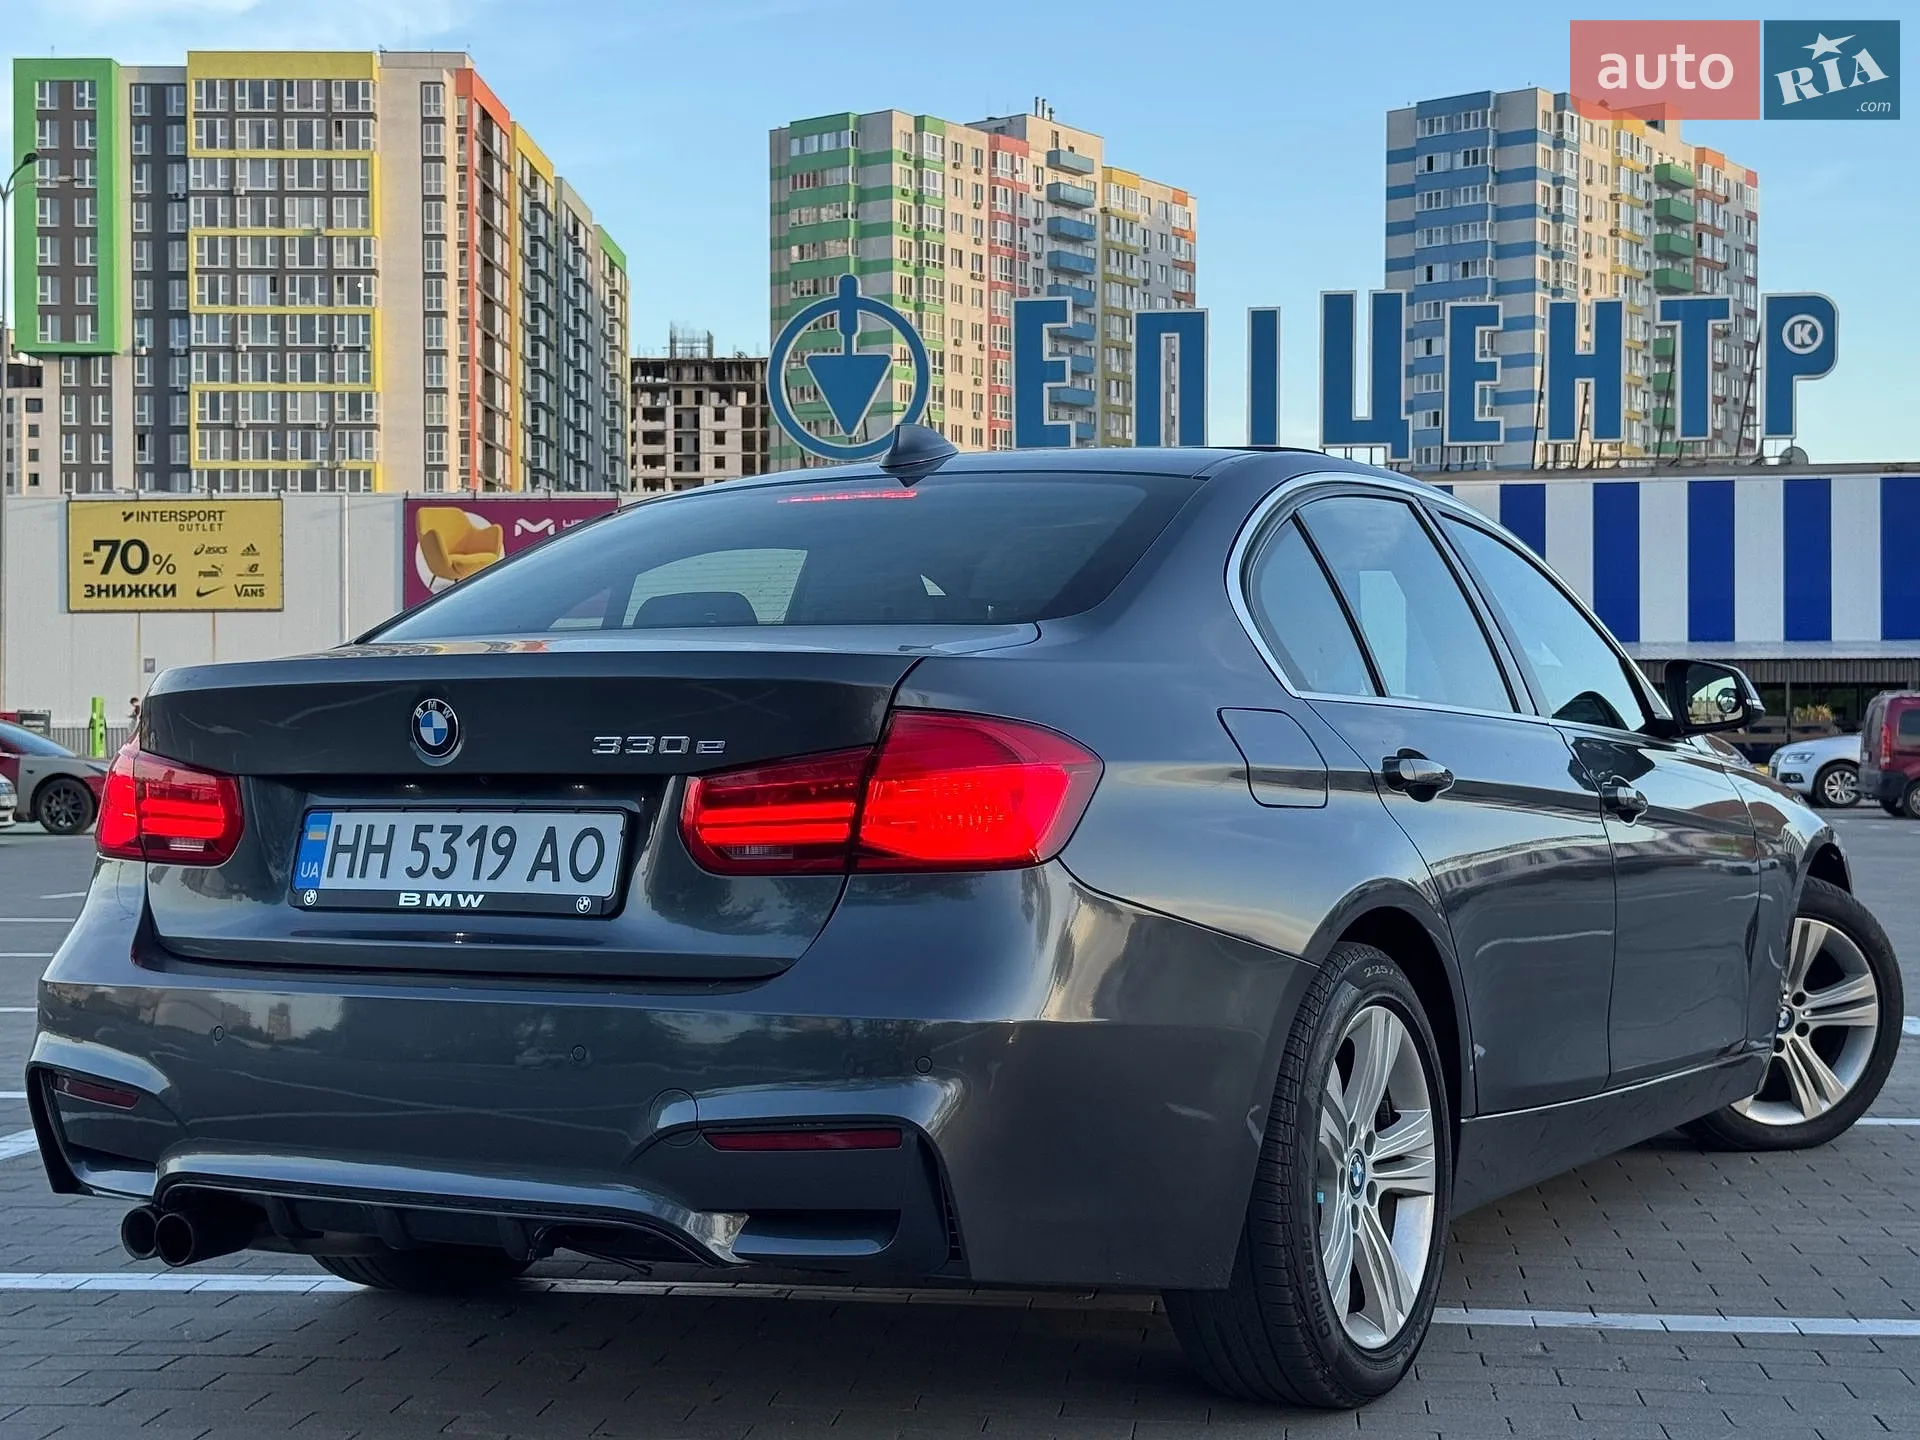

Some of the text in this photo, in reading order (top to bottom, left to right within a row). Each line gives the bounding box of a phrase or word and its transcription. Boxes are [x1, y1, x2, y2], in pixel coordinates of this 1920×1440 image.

[1012, 290, 1839, 462] ЕПІЦЕНТР
[136, 510, 226, 523] INTERSPORT
[178, 523, 224, 532] OUTLET
[83, 538, 177, 576] -70%
[83, 583, 177, 599] ЗНИЖКИ
[592, 736, 726, 755] 330e
[326, 823, 605, 883] HH 5319 AO
[300, 864, 319, 879] UA
[398, 892, 485, 908] BMW
